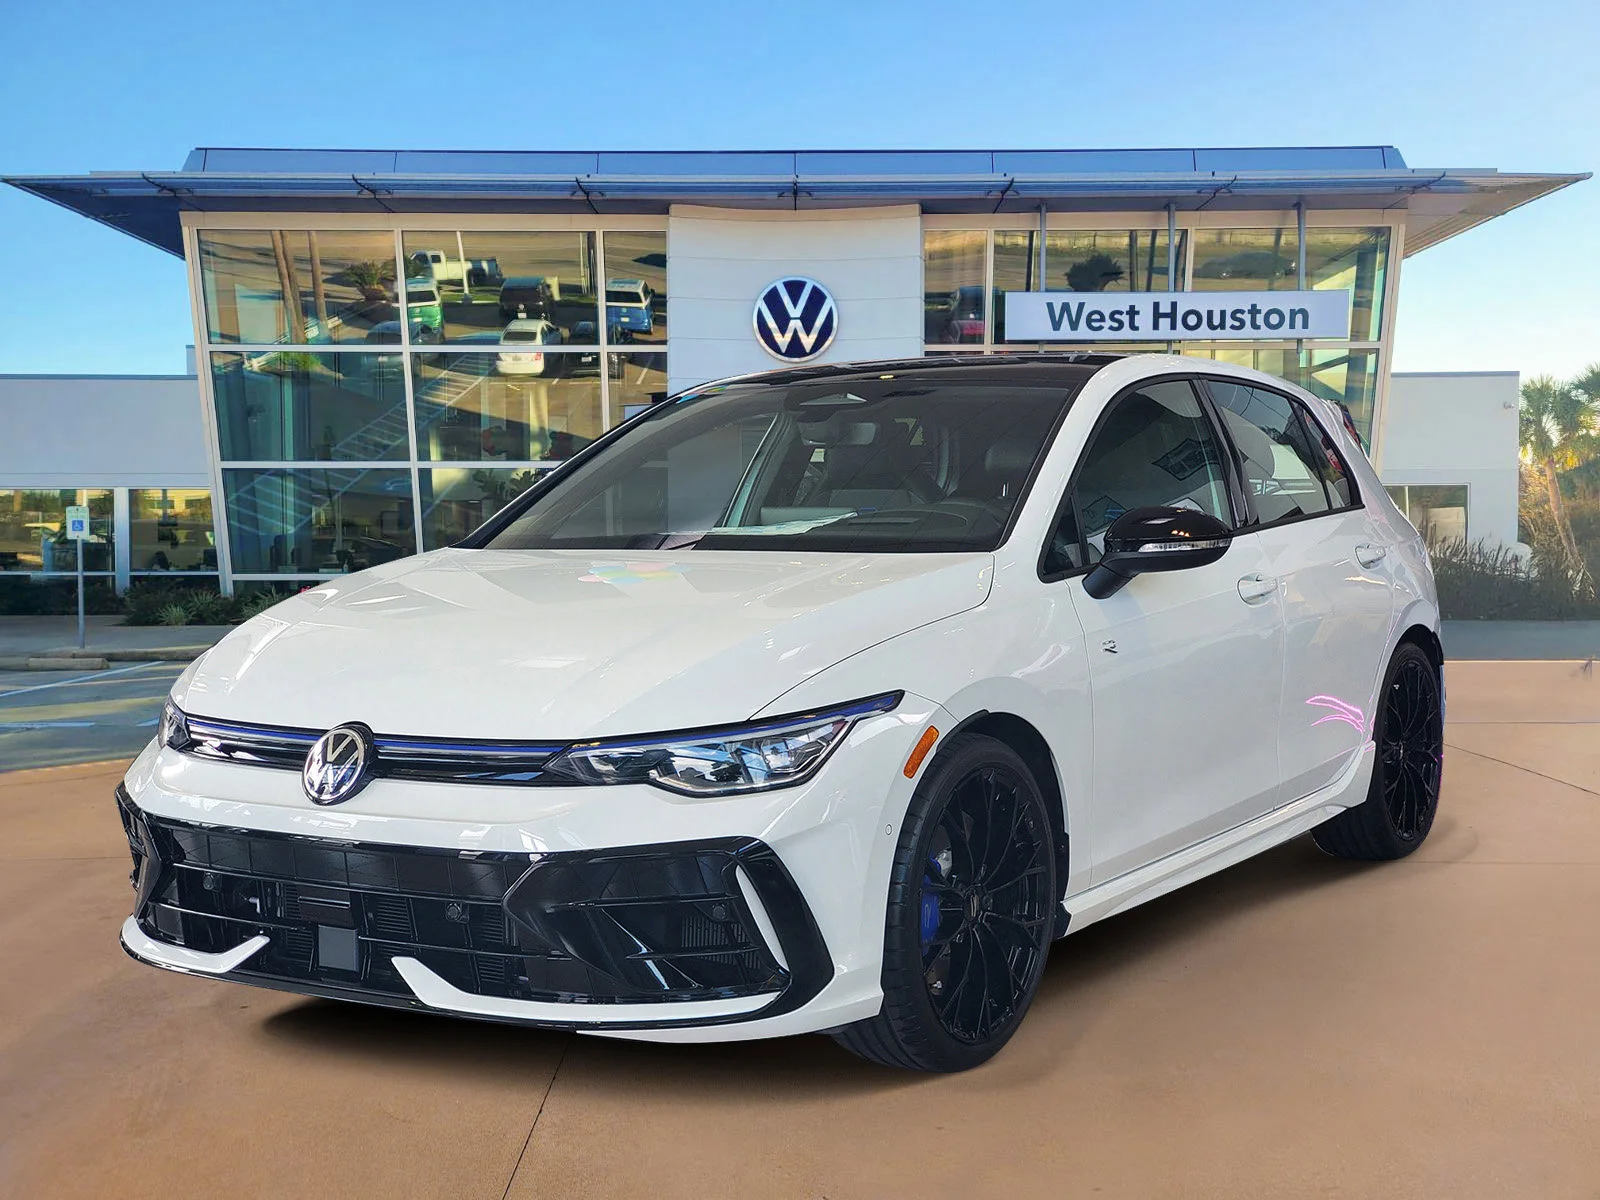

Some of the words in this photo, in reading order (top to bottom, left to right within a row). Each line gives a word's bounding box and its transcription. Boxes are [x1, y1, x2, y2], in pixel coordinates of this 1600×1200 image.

[754, 277, 838, 362] VW
[1046, 301, 1140, 332] West
[1152, 300, 1310, 332] Houston
